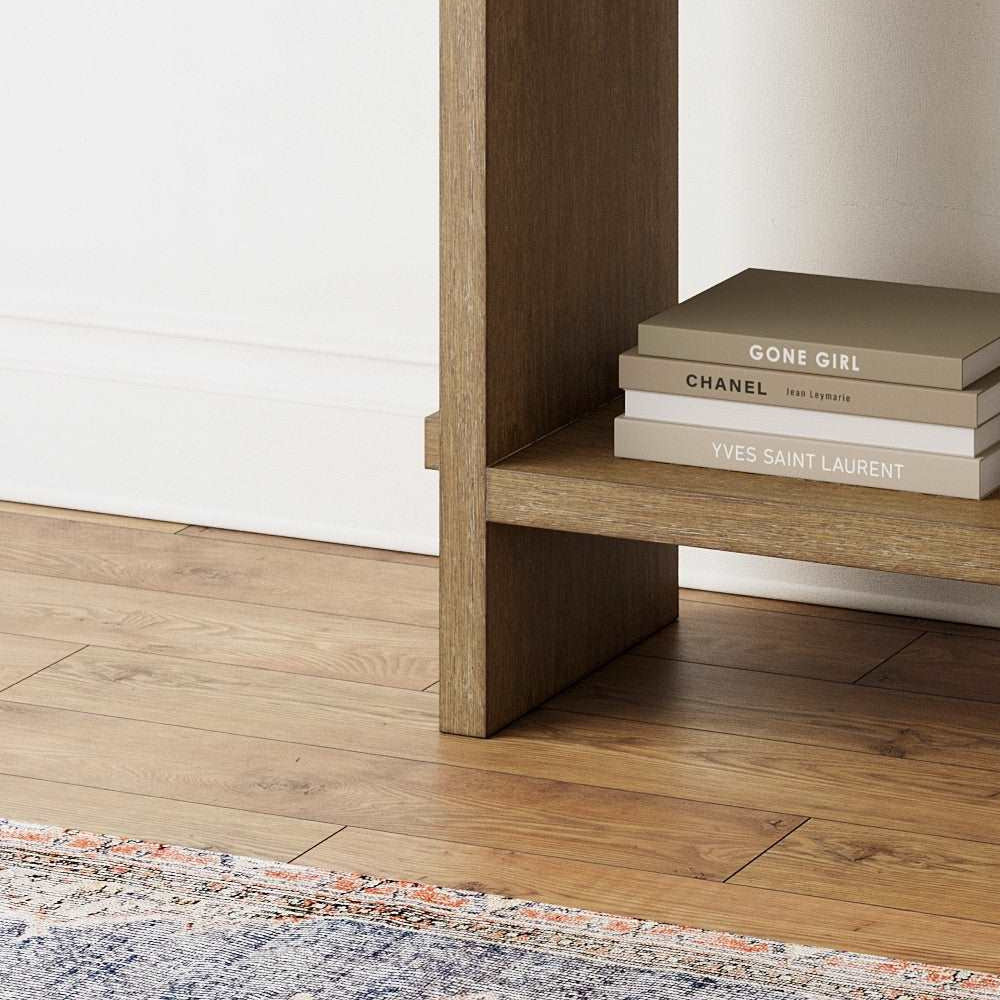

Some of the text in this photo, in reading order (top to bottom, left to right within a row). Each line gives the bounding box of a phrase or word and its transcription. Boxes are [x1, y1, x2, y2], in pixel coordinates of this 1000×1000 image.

[749, 344, 860, 372] GONE GIRL
[686, 374, 767, 396] CHANEL
[786, 387, 806, 397] Jean
[711, 441, 904, 481] YVES SAINT LAURENT
